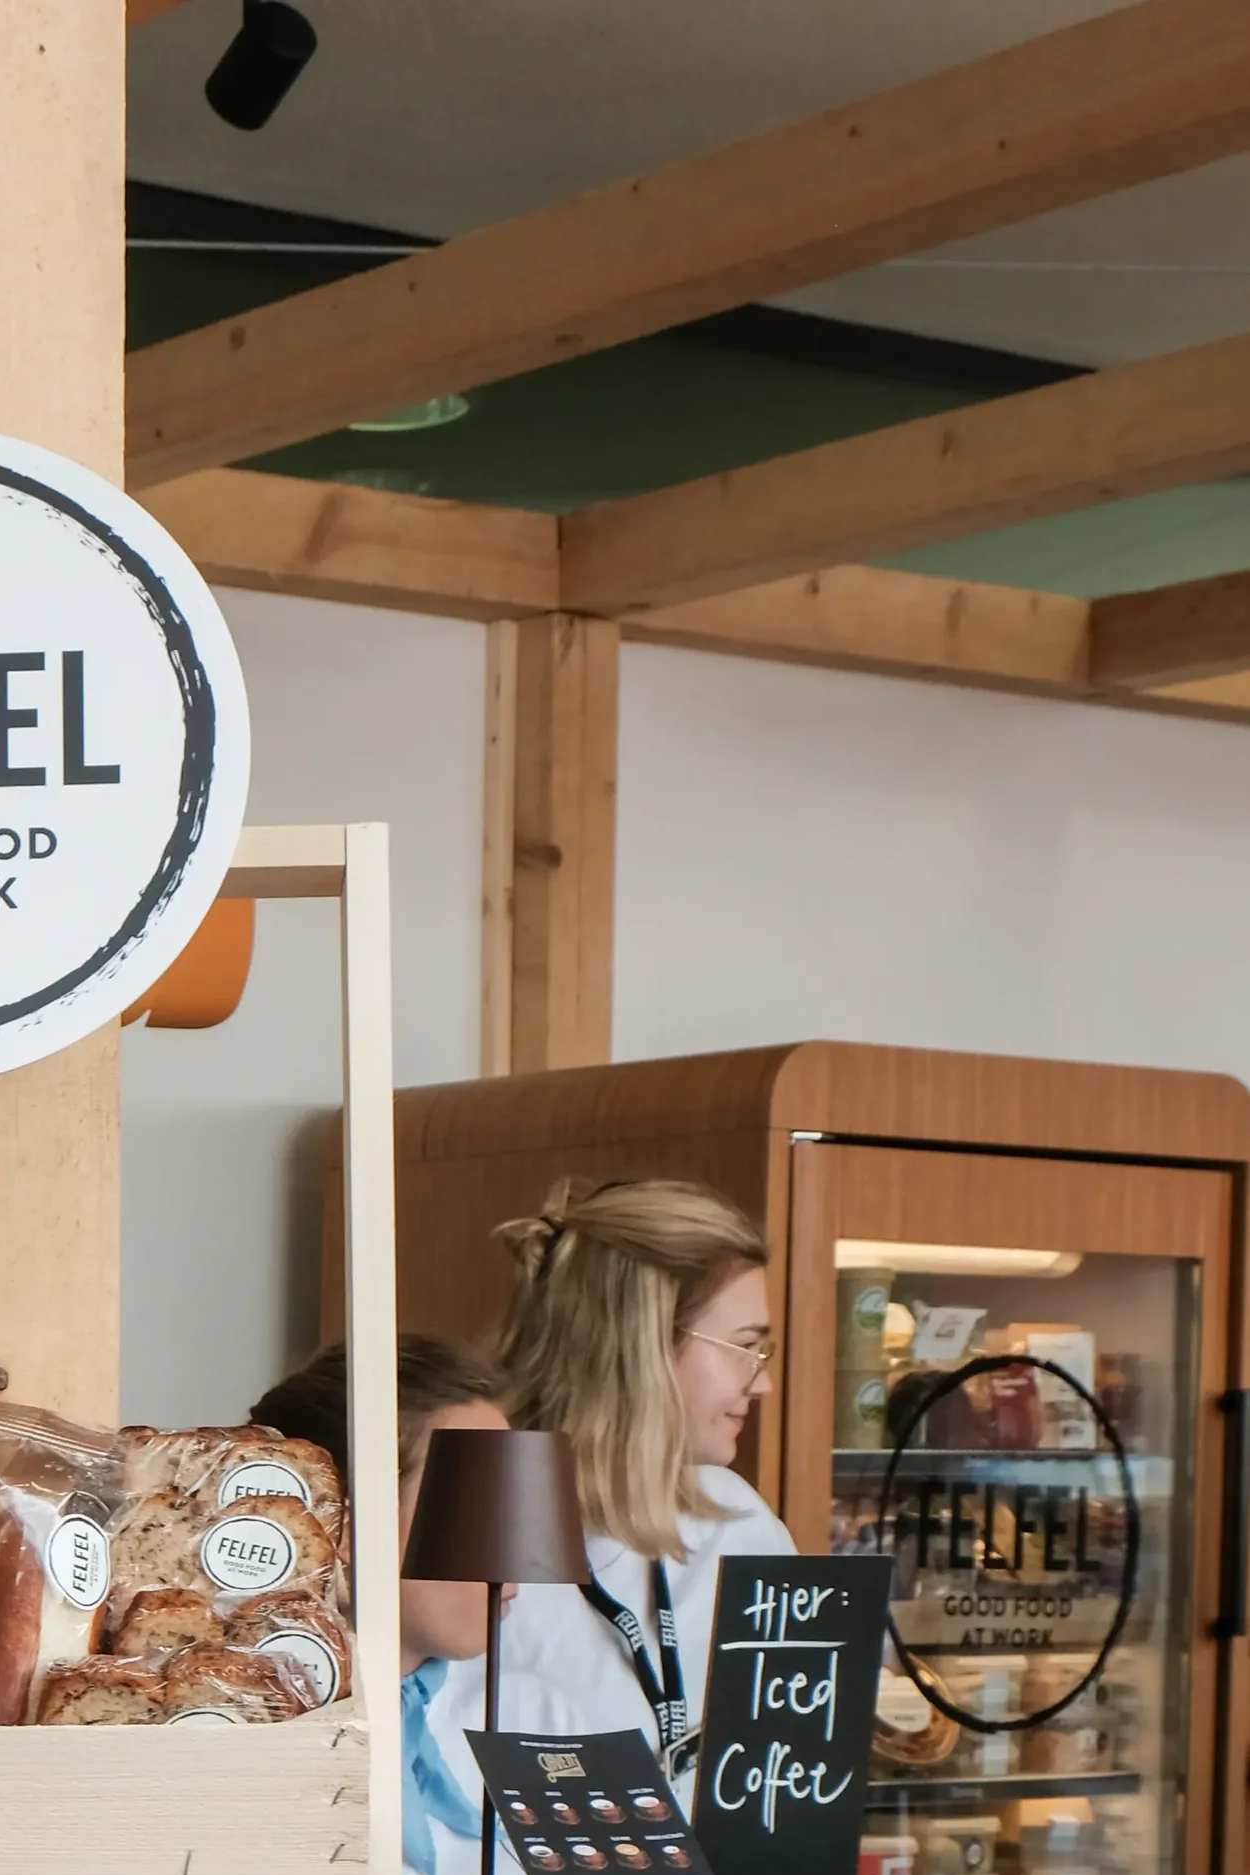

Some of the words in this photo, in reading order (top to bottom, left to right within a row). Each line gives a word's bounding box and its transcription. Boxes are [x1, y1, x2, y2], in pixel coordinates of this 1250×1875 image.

[217, 1536, 278, 1566] FELFEL
[917, 1481, 1101, 1572] FELFEL
[72, 1531, 90, 1593] FELFEL
[943, 1596, 1007, 1618] GOOD
[1013, 1596, 1073, 1618] FOOD
[960, 1627, 987, 1649] AT
[991, 1628, 1054, 1649] WORK
[752, 1650, 838, 1742] Iced
[715, 1741, 853, 1834] Coffee
